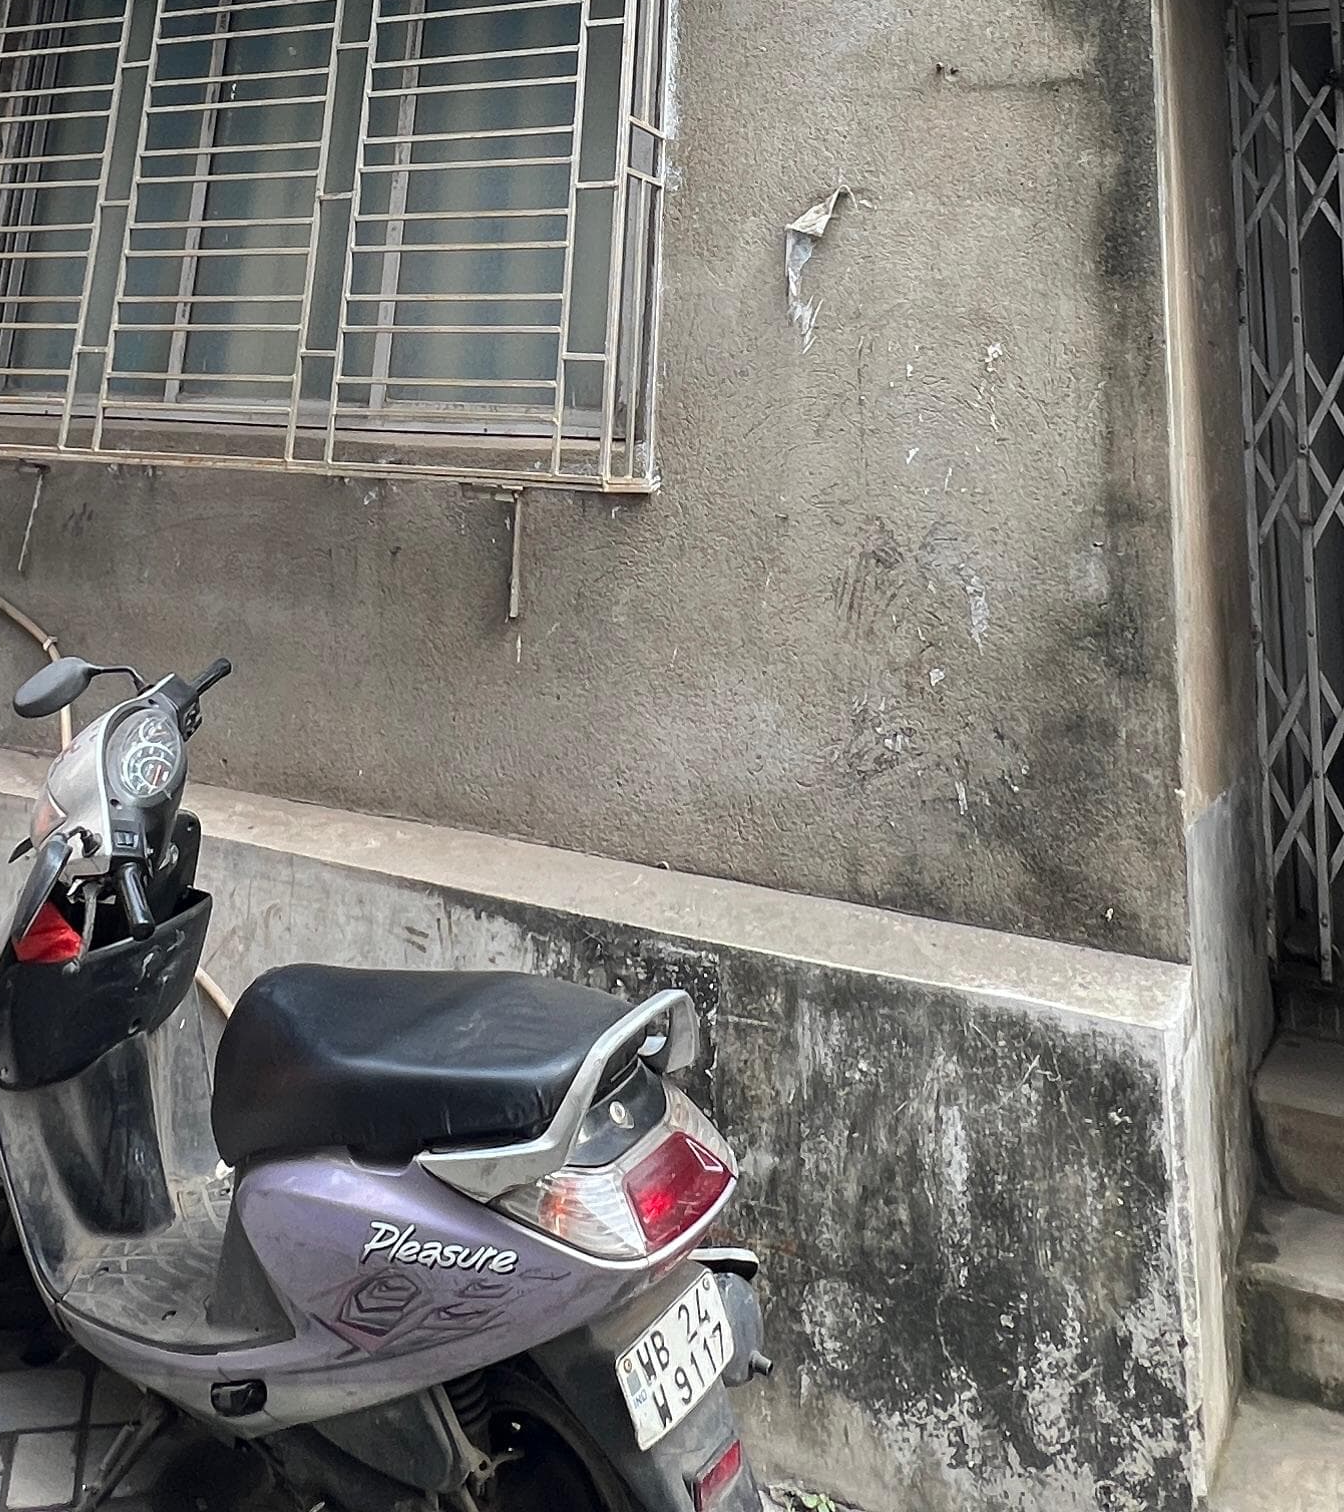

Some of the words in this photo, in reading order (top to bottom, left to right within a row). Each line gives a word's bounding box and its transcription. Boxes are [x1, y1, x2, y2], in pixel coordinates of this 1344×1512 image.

[360, 1221, 518, 1274] Pleasure
[636, 1330, 670, 1381] WB
[678, 1288, 710, 1344] 24
[633, 1389, 648, 1409] IND
[652, 1384, 673, 1429] W
[674, 1321, 724, 1405] 9117
